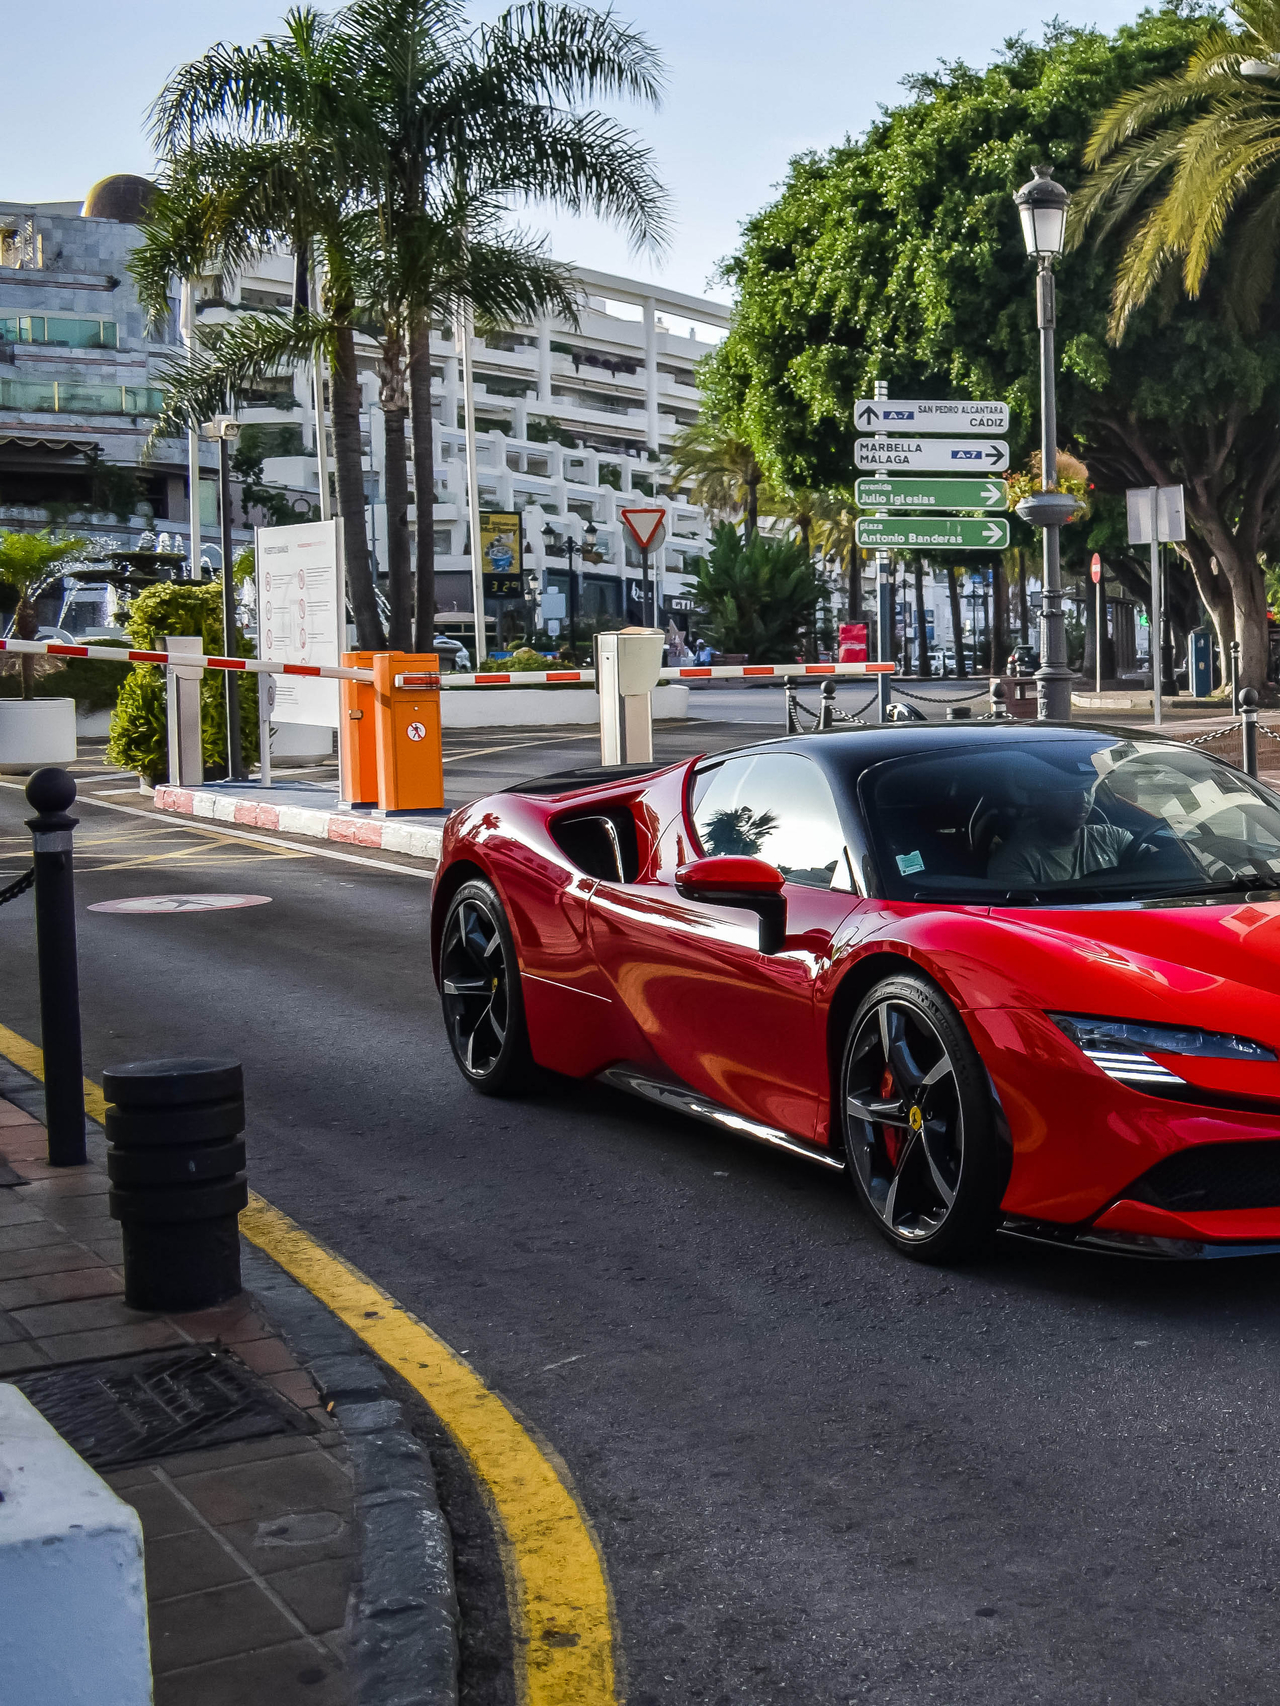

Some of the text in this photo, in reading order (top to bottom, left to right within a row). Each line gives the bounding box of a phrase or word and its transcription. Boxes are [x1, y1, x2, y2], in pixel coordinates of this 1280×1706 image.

[888, 411, 910, 419] A-7
[918, 405, 933, 414] SAN
[935, 405, 959, 414] PEDRO
[969, 415, 1004, 427] CÁDIZ
[859, 443, 977, 459] MARBELLA A-7
[859, 453, 910, 464] MÁLAGA
[859, 483, 892, 491] avenida
[860, 494, 936, 505] Julio Iglesias
[859, 522, 883, 531] plaza
[860, 533, 963, 544] Antonio Banderas
